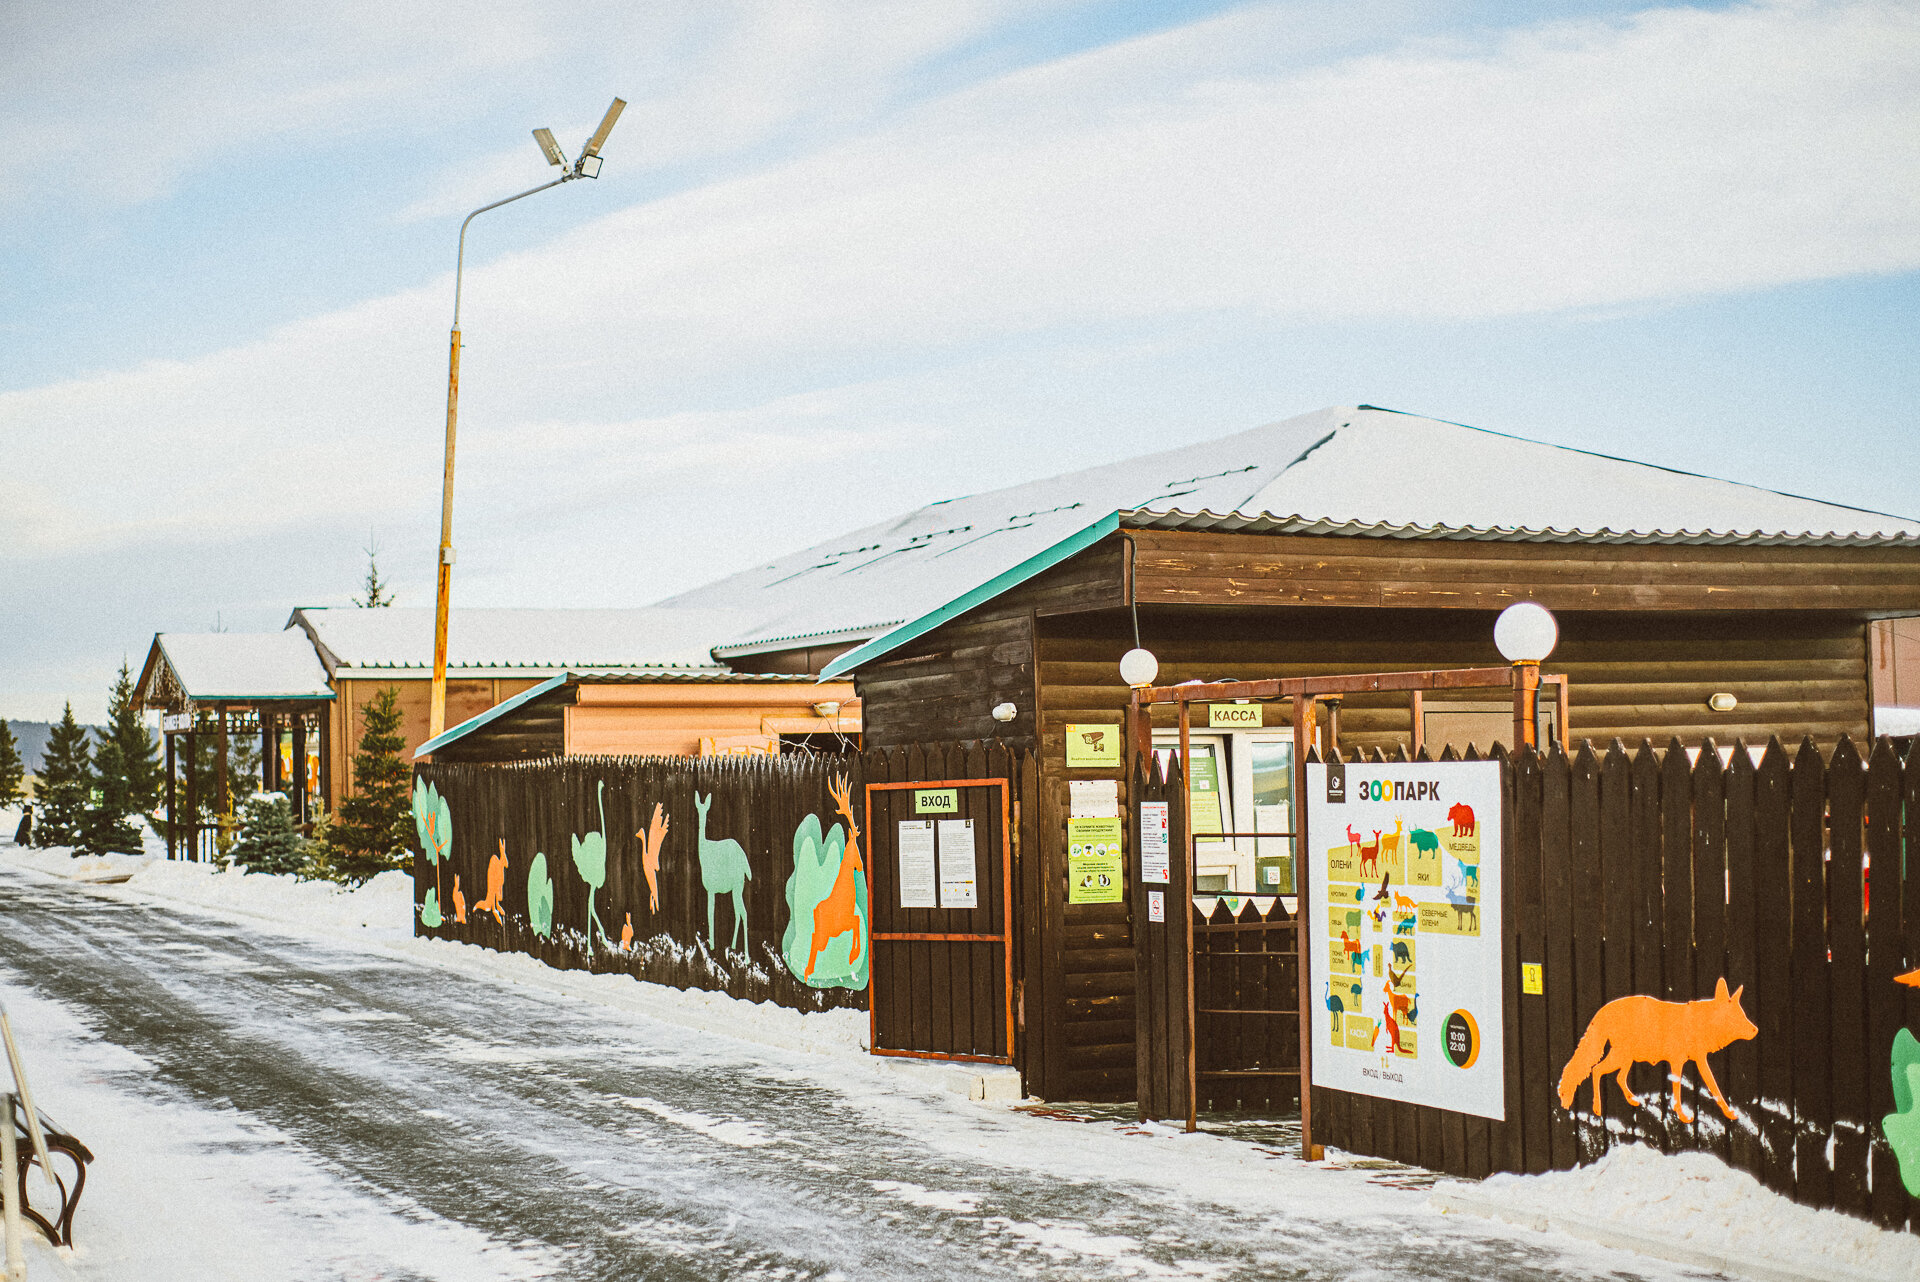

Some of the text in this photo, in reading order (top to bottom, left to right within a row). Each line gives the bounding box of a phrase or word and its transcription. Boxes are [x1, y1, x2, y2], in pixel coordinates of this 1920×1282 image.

[1214, 709, 1257, 722] КАССА
[1358, 779, 1440, 802] ЗООПАРК
[921, 795, 951, 809] ВХОД
[1448, 843, 1477, 852] МЕДВЕДЬ
[1330, 859, 1352, 870] ОЛЕНИ
[1417, 873, 1429, 882] ЯКИ
[1421, 909, 1448, 918] СЕВЕРНЫЕ
[1421, 919, 1439, 927] ОЛЕНИ
[1349, 1029, 1368, 1039] КАССА
[1450, 1031, 1466, 1042] 10:00
[1450, 1042, 1466, 1052] 22:00
[1362, 1068, 1379, 1079] ВХОД
[1382, 1071, 1404, 1084] ВЫХОД
